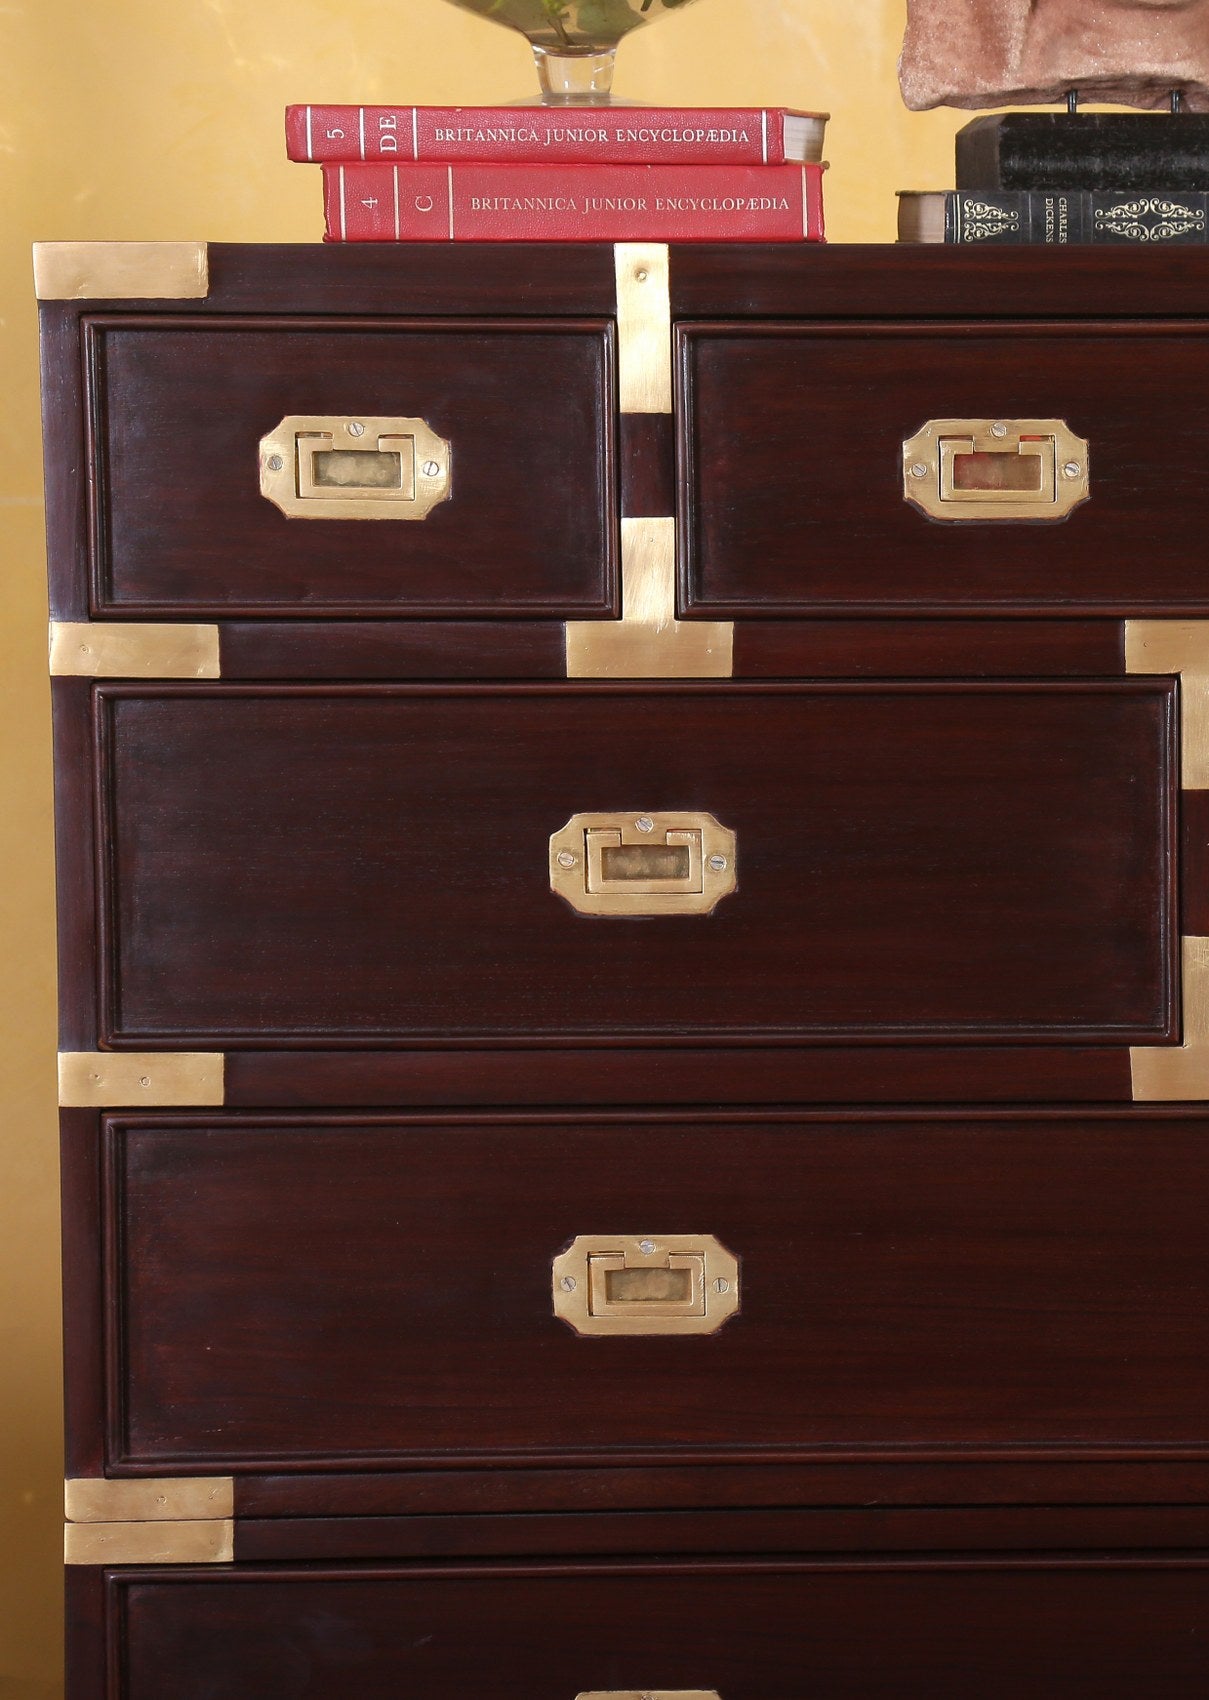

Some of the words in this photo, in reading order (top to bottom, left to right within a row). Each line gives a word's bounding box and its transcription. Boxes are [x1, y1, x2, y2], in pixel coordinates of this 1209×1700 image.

[326, 128, 345, 139] 5
[434, 128, 539, 142] BRITANNICA
[543, 128, 609, 146] JUNIOR
[616, 128, 749, 142] ENCYCLOPÆDIA
[361, 196, 378, 209] 4
[414, 195, 434, 212] C
[470, 197, 577, 211] BRITANNICA
[582, 197, 647, 214] JUNIOR
[655, 197, 790, 211] ENCYCLOPÆDIA
[1045, 197, 1054, 243] DICKENS
[1058, 197, 1068, 244] CHARLES
